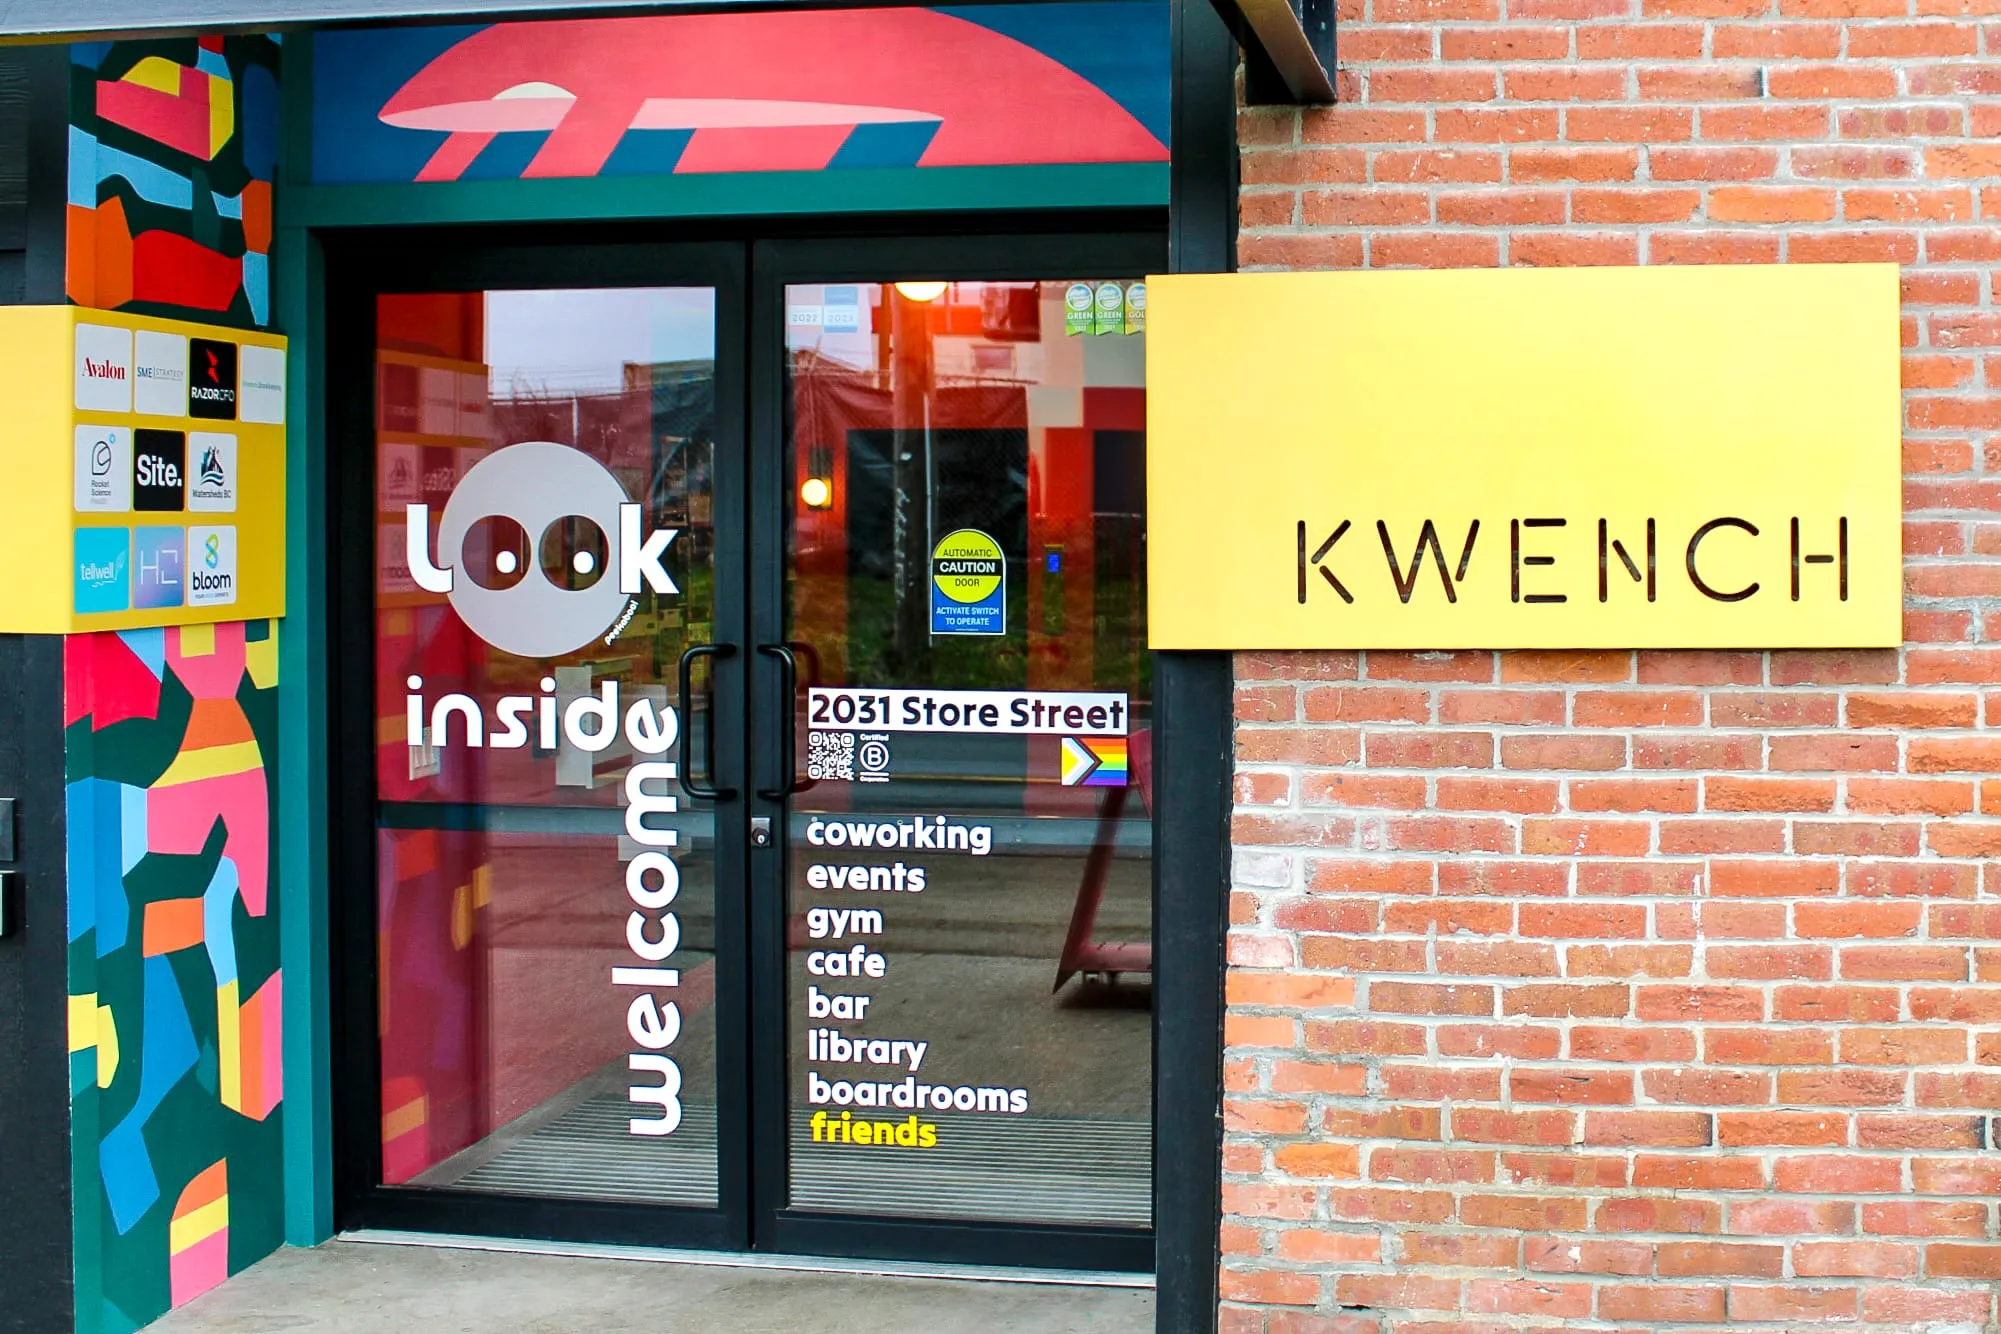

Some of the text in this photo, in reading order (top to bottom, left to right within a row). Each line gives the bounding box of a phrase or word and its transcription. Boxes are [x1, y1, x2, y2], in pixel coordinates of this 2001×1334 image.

[1067, 311, 1093, 320] GREEN
[1096, 311, 1122, 319] GREEN
[1128, 311, 1145, 319] GOL
[81, 357, 125, 380] Avalon
[137, 366, 152, 379] SME
[191, 386, 235, 402] RAZORCFO
[136, 453, 183, 487] Site.
[406, 503, 680, 594] look
[942, 548, 992, 557] AUTOMATIC
[939, 561, 996, 573] CAUTION
[1296, 516, 1848, 604] KWENCH
[80, 562, 115, 581] tellwell
[192, 571, 232, 591] bloom
[954, 578, 980, 587] DOOR
[935, 606, 999, 615] ACTIVATE SWITCH
[945, 617, 990, 626] TO OPERATE
[811, 694, 1124, 729] 2031 Store Street
[860, 733, 890, 742] Certified
[867, 747, 882, 766] B
[806, 815, 993, 855] coworking
[806, 862, 927, 892] events
[611, 698, 682, 1136] welcome
[806, 907, 884, 939] gym
[806, 944, 887, 978] cafe
[807, 985, 870, 1020] bar
[807, 1028, 928, 1071] library
[807, 1072, 1029, 1113] boardrooms
[809, 1111, 938, 1148] friends
